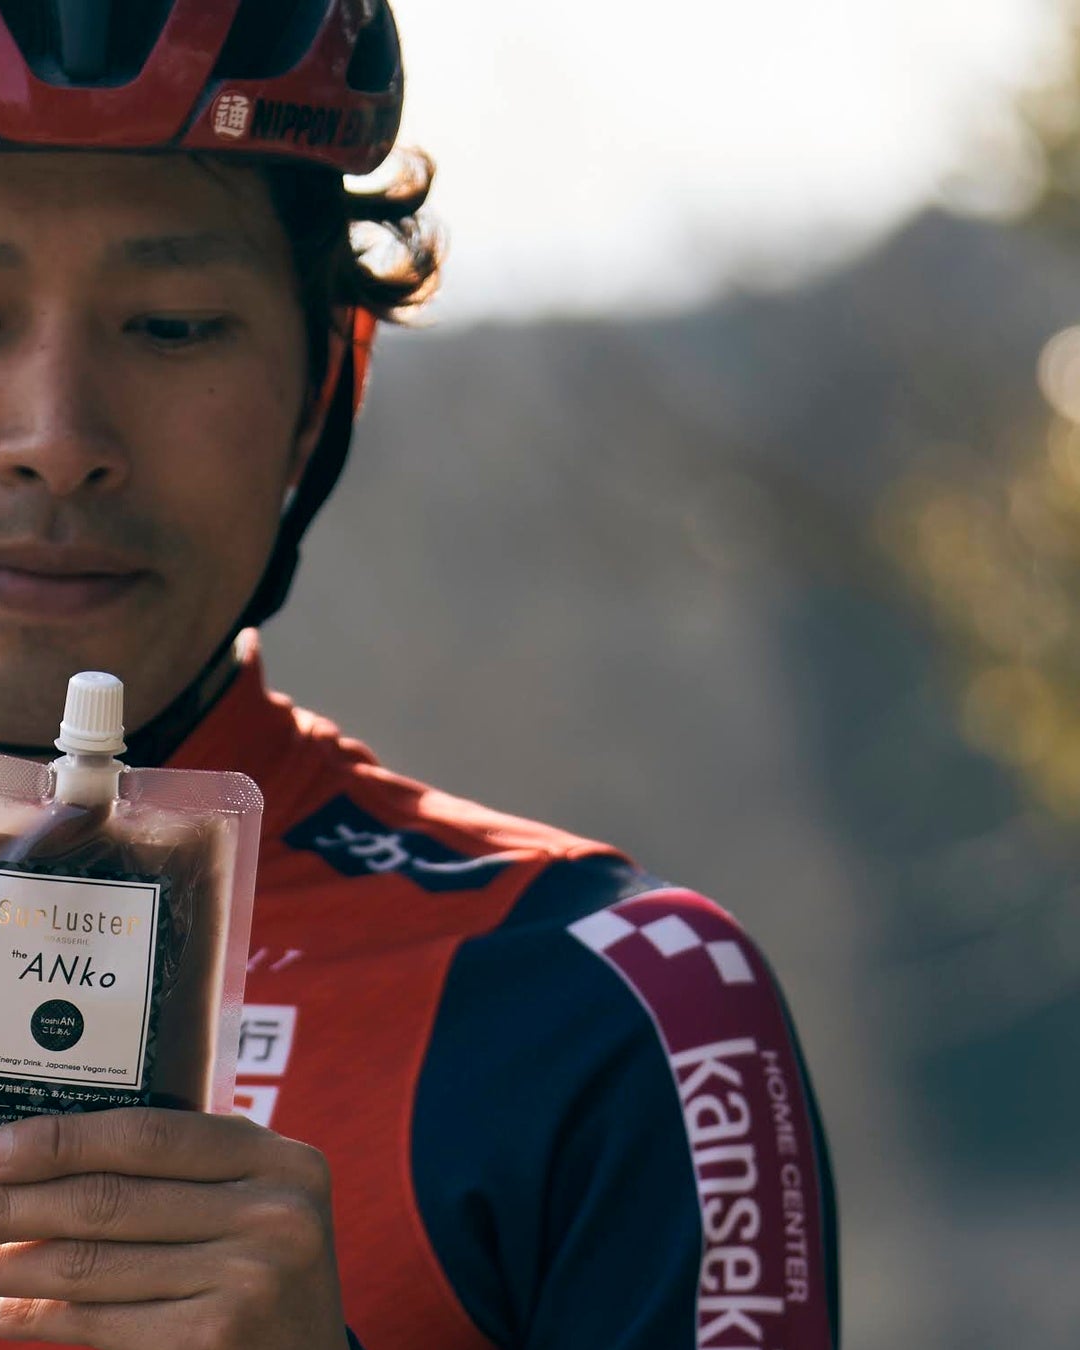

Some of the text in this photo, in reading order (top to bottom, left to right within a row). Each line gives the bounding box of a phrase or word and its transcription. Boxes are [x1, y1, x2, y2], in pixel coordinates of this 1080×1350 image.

[11, 949, 117, 989] the ANko
[45, 1061, 81, 1072] Japanese
[82, 1065, 107, 1075] Vegan
[762, 1050, 809, 1304] HOME CENTER
